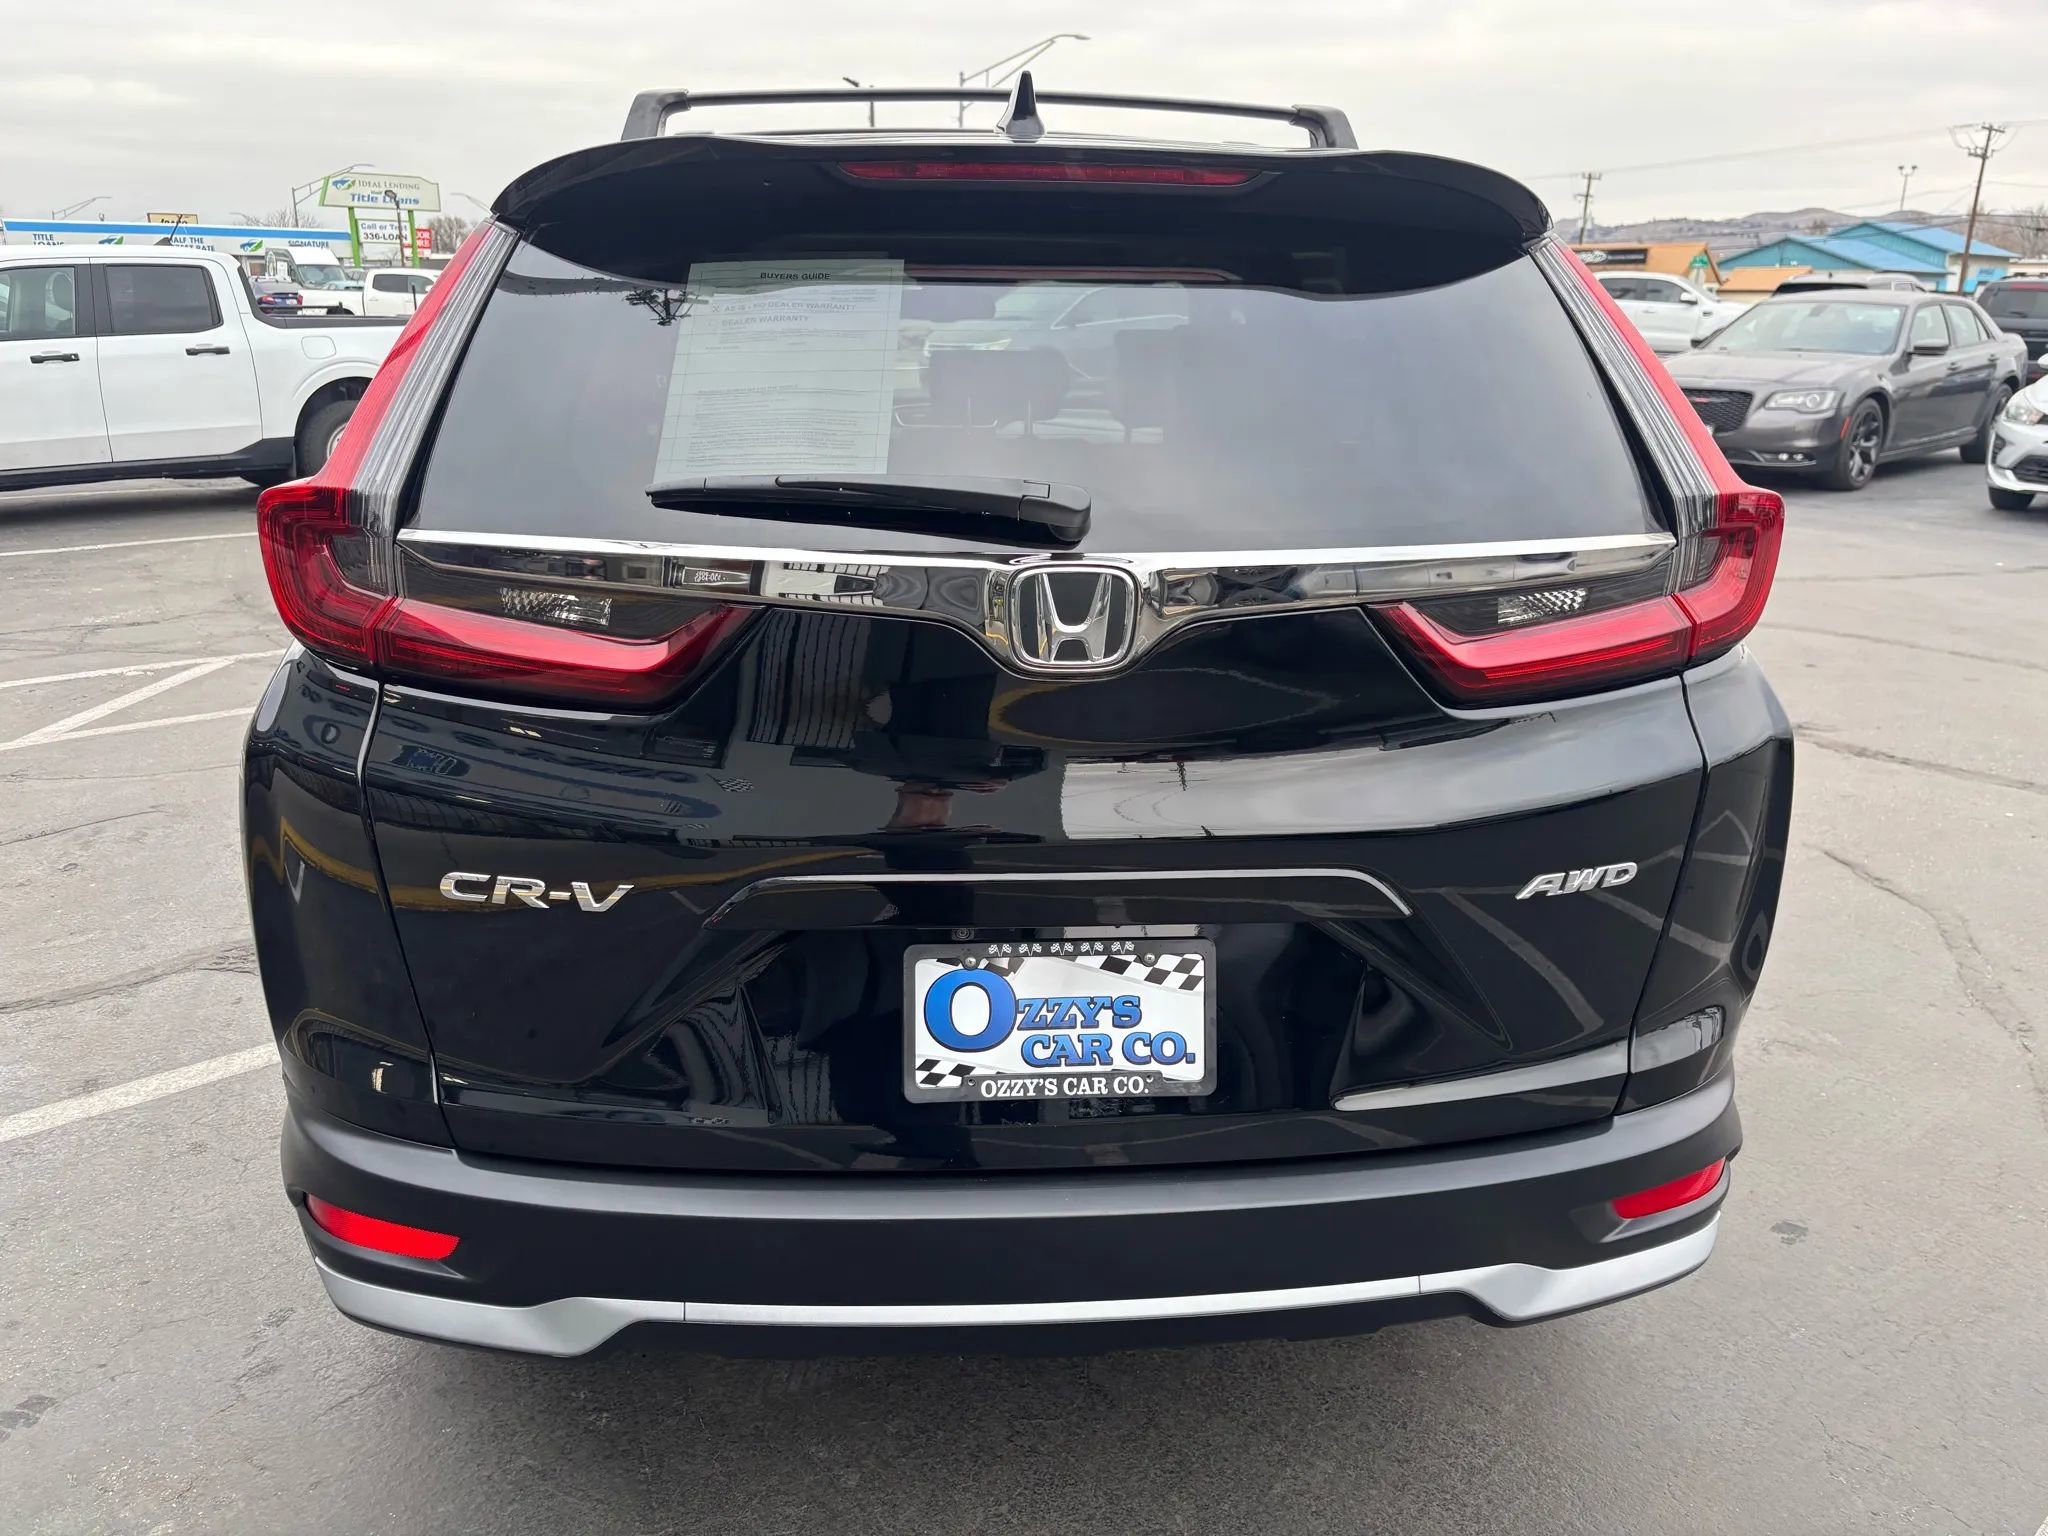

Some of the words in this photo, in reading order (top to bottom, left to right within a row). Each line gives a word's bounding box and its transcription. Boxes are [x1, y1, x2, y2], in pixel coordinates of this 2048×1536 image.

[358, 179, 381, 189] IDEAL
[384, 180, 420, 190] LENDING
[350, 192, 378, 203] Title
[360, 222, 377, 231] Call
[32, 233, 55, 241] TITLE
[172, 236, 187, 245] ALF
[190, 237, 204, 245] THE
[760, 271, 799, 281] BUYERS
[801, 272, 831, 281] GUIDE
[1515, 861, 1638, 900] AWD
[439, 871, 635, 912] CR-V
[923, 967, 1143, 1054] OZZY'S
[1020, 1033, 1113, 1069] CAR
[1121, 1031, 1197, 1066] CO.
[980, 1078, 1058, 1098] OZZY'S
[1062, 1077, 1108, 1096] CAR
[1113, 1075, 1149, 1095] CO.
